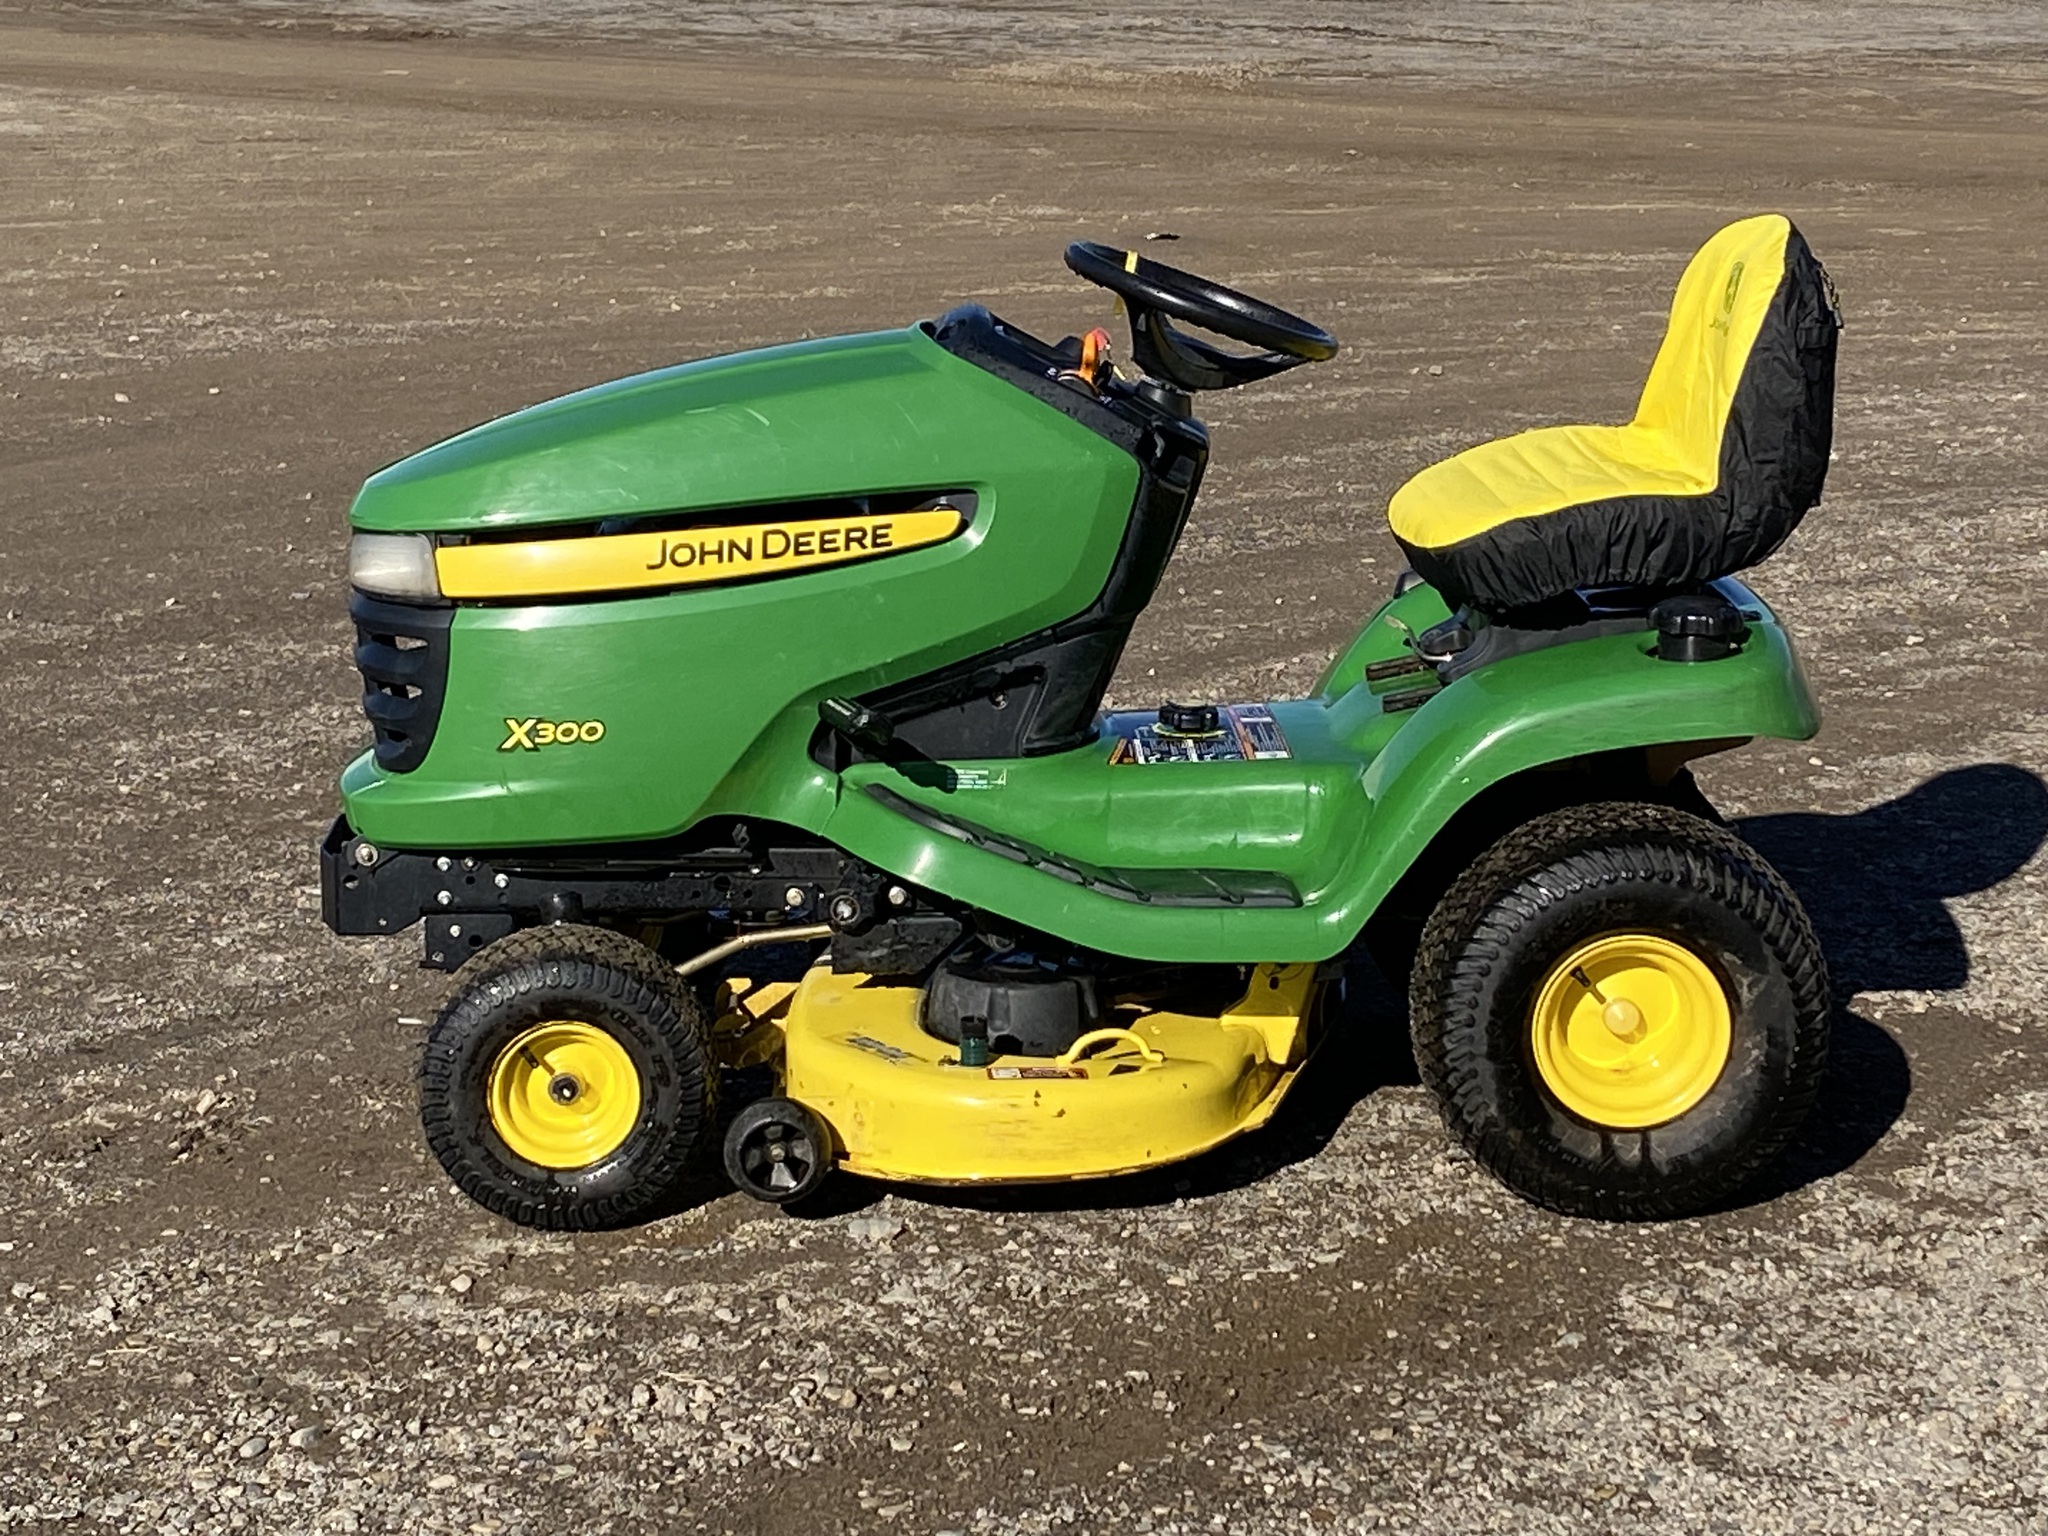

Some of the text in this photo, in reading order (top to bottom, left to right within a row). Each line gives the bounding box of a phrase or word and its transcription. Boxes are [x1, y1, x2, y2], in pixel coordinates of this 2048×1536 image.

[646, 523, 893, 570] JOHN DEERE
[498, 717, 606, 751] X300
